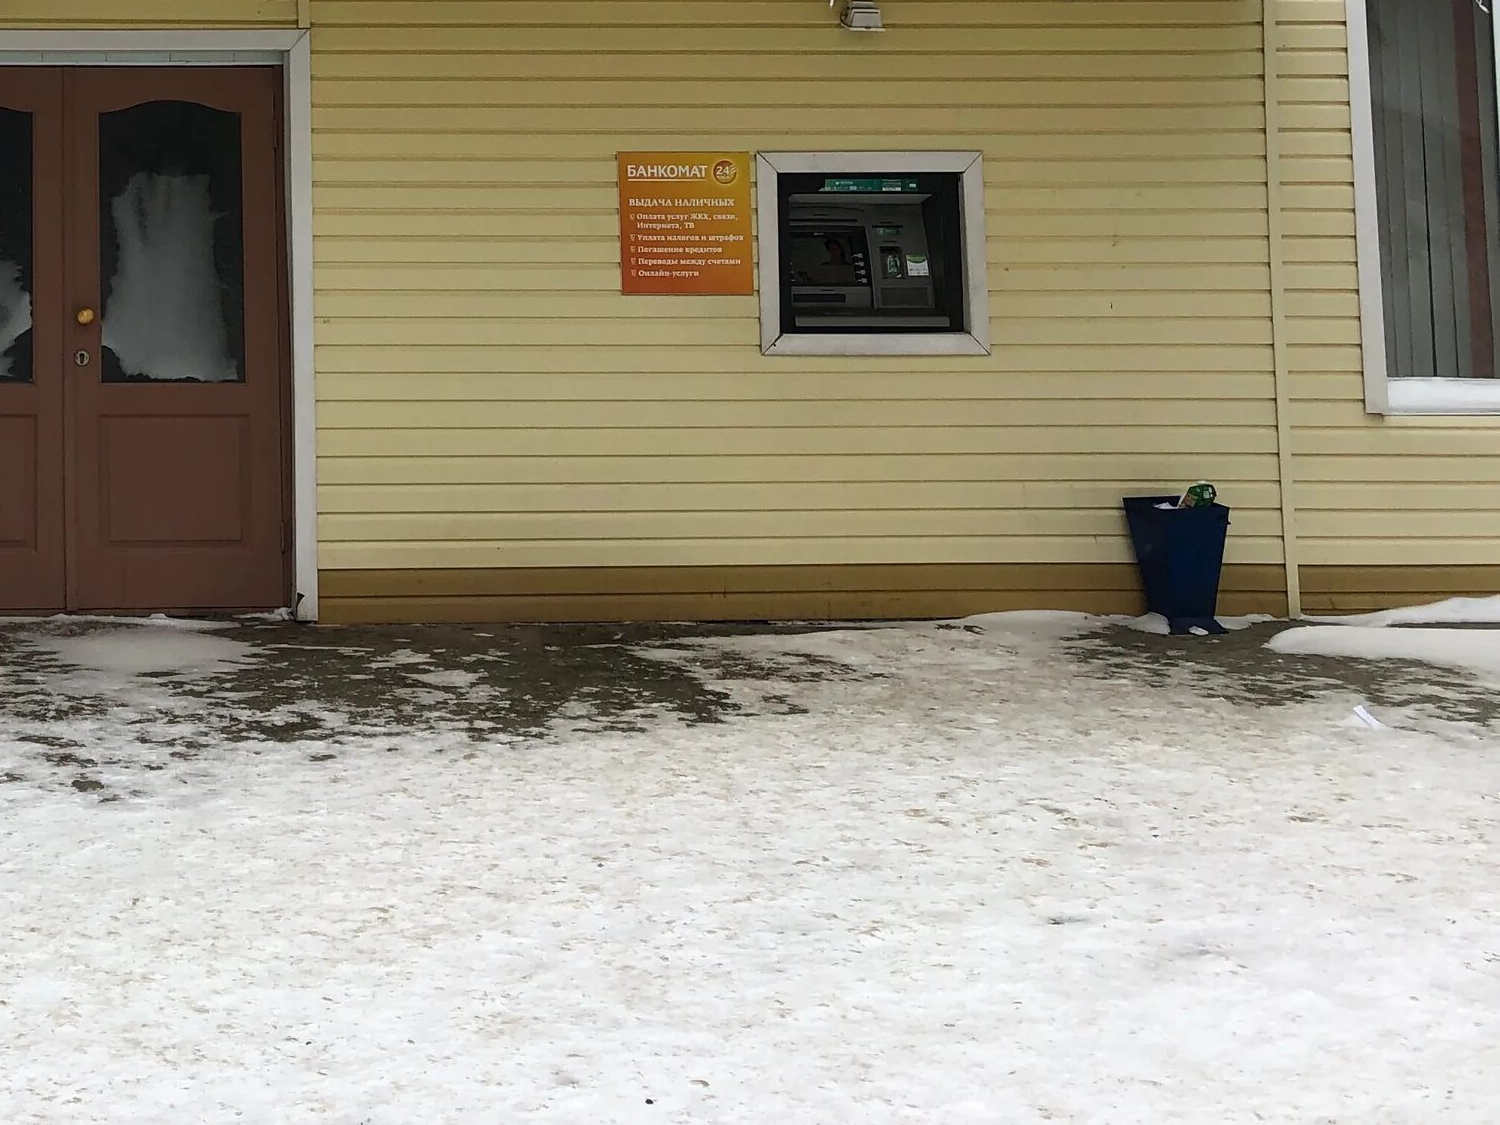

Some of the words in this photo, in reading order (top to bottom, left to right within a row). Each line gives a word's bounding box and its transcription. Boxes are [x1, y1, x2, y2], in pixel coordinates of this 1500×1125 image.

[627, 164, 708, 178] БАНКОМАТ
[715, 165, 730, 176] 24
[628, 198, 673, 208] ВЫДАЧА
[674, 198, 735, 207] НАЛИЧНЫХ
[636, 221, 683, 230] Интернета,
[684, 221, 695, 229] ТВ
[708, 233, 744, 243] штрафов
[638, 257, 678, 266] Переводы
[679, 258, 707, 266] между
[638, 269, 700, 278] Онлайн-услуги
